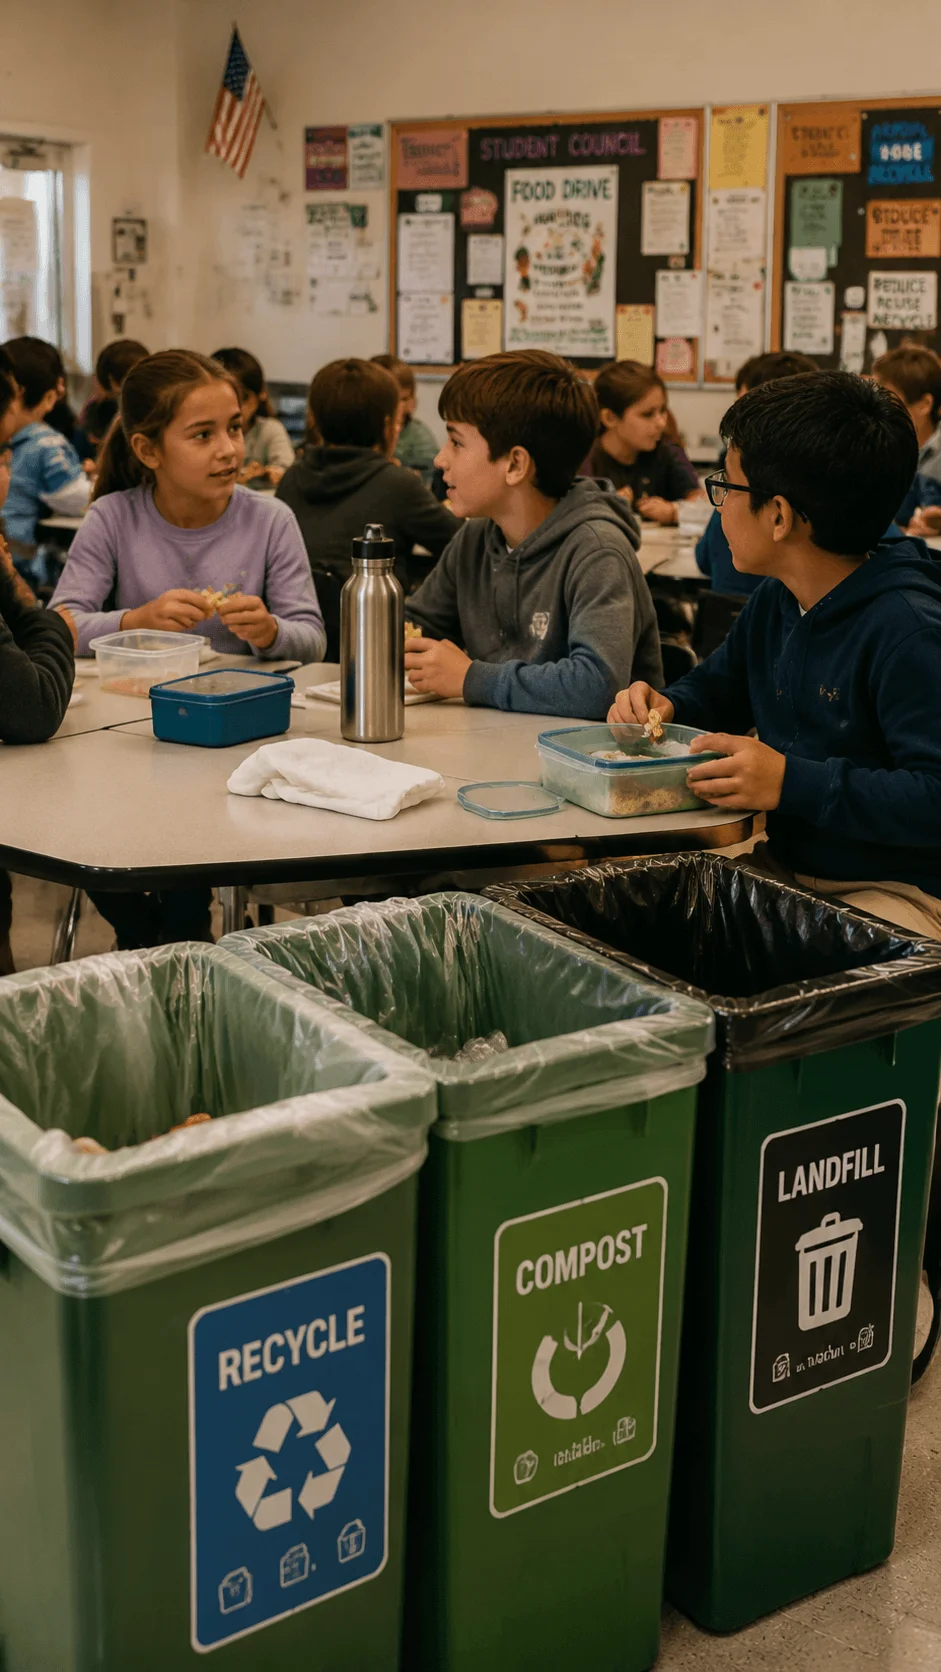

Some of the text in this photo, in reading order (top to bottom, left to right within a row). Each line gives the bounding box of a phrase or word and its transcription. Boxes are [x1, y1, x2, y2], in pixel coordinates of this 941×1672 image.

[480, 135, 559, 161] STUDENT
[568, 132, 647, 157] COUNCIL
[510, 178, 612, 203] FOOD DRIVE
[778, 1144, 885, 1202] LANDFILL
[515, 1223, 648, 1296] COMPOST
[218, 1304, 366, 1391] RECYCLE
